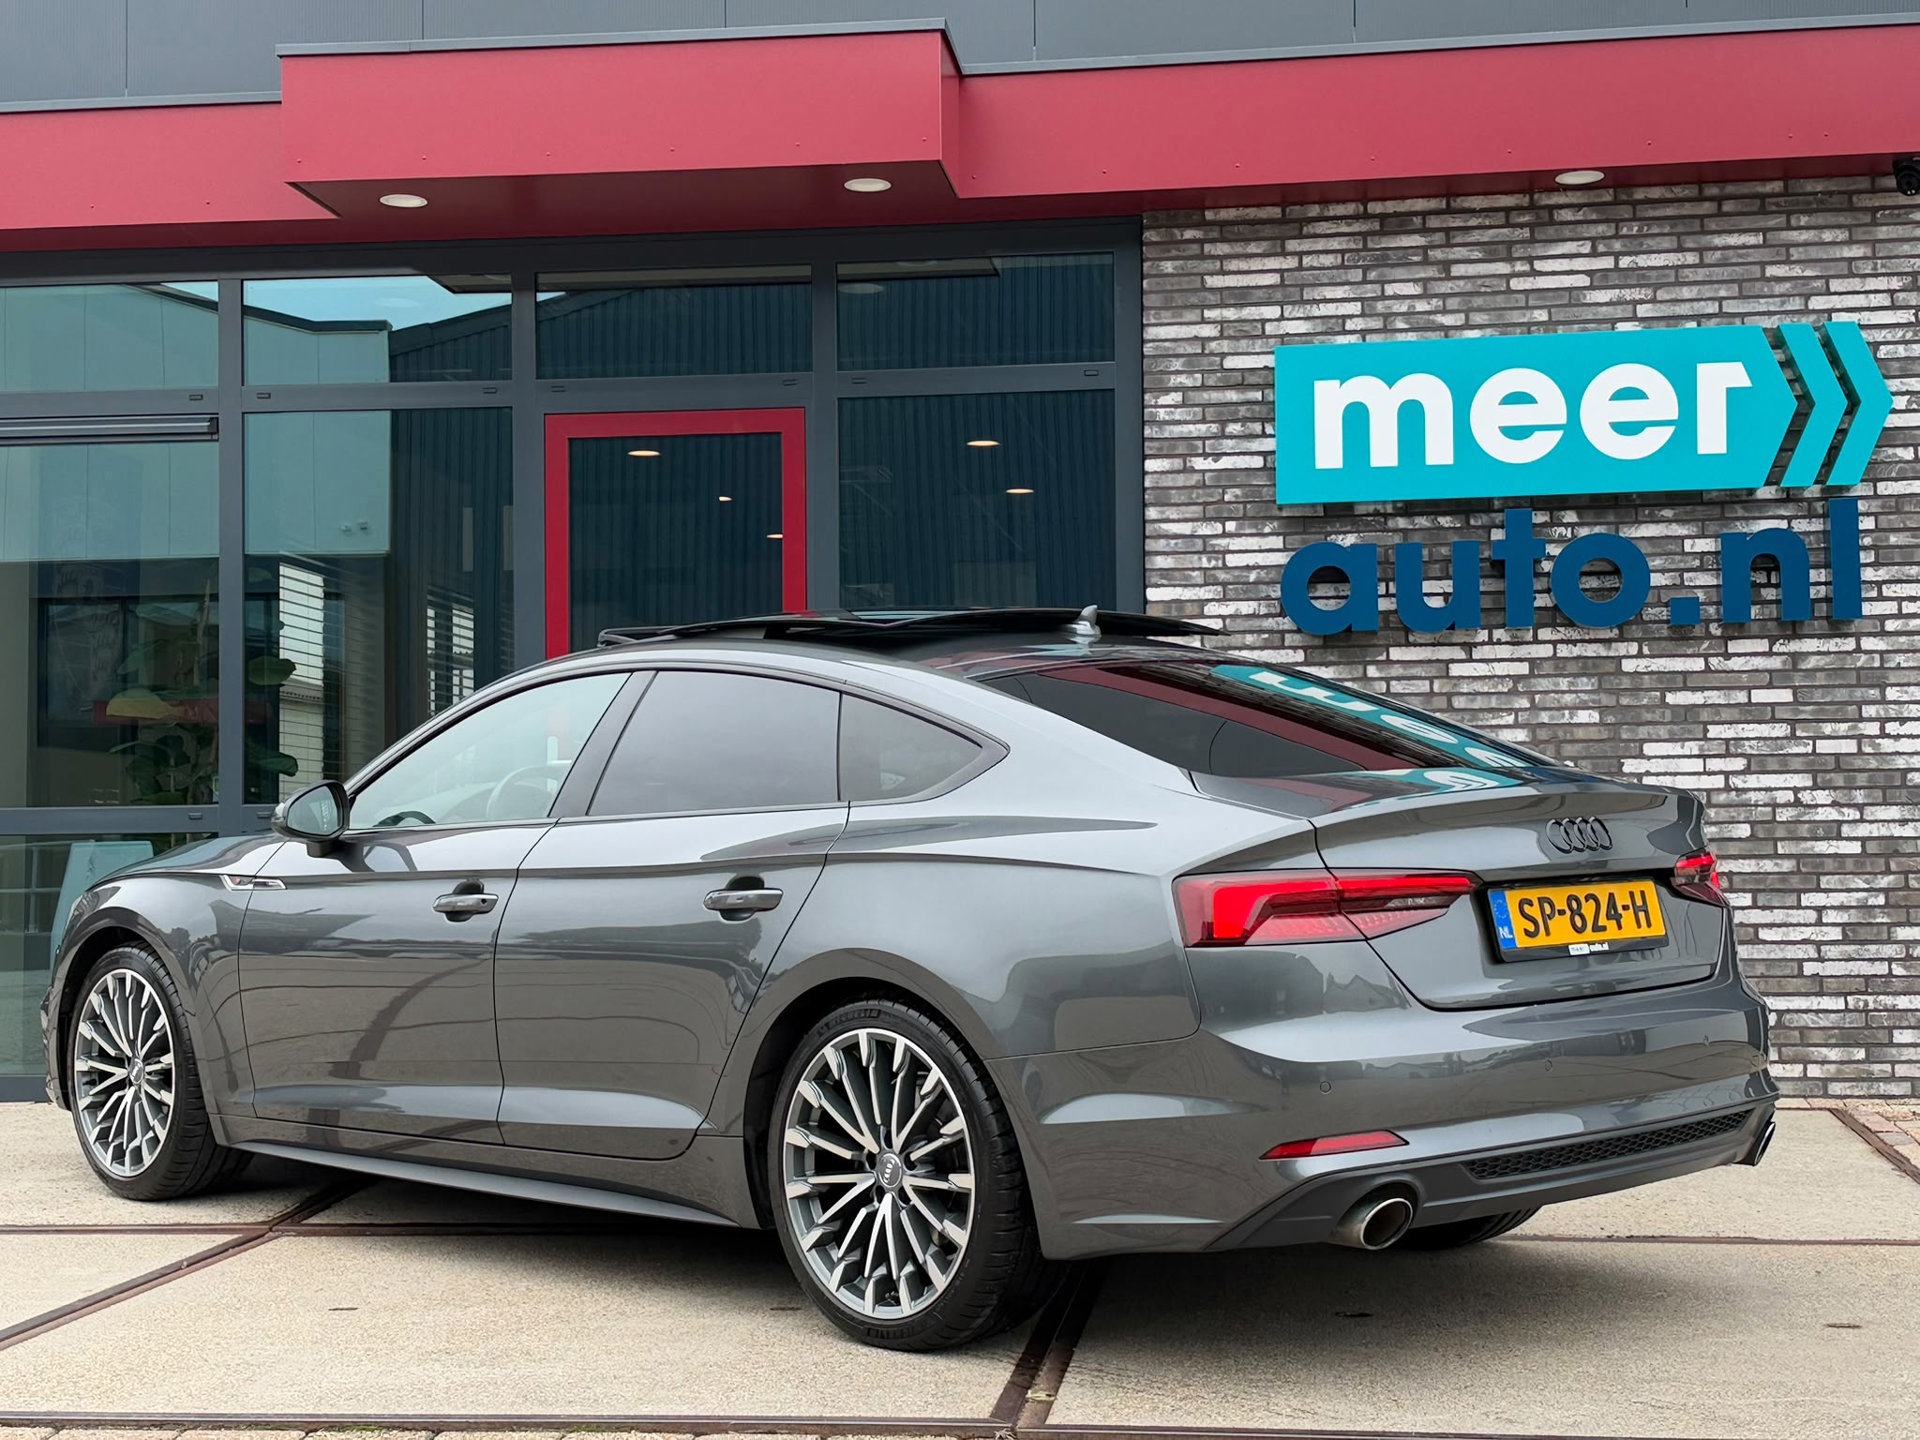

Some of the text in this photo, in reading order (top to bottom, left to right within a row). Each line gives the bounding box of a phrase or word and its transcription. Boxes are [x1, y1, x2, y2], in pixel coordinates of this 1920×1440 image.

[1313, 361, 1753, 470] meer
[1280, 498, 1863, 635] auto.nl
[1499, 926, 1513, 939] NL
[1518, 890, 1652, 938] SP-824-H
